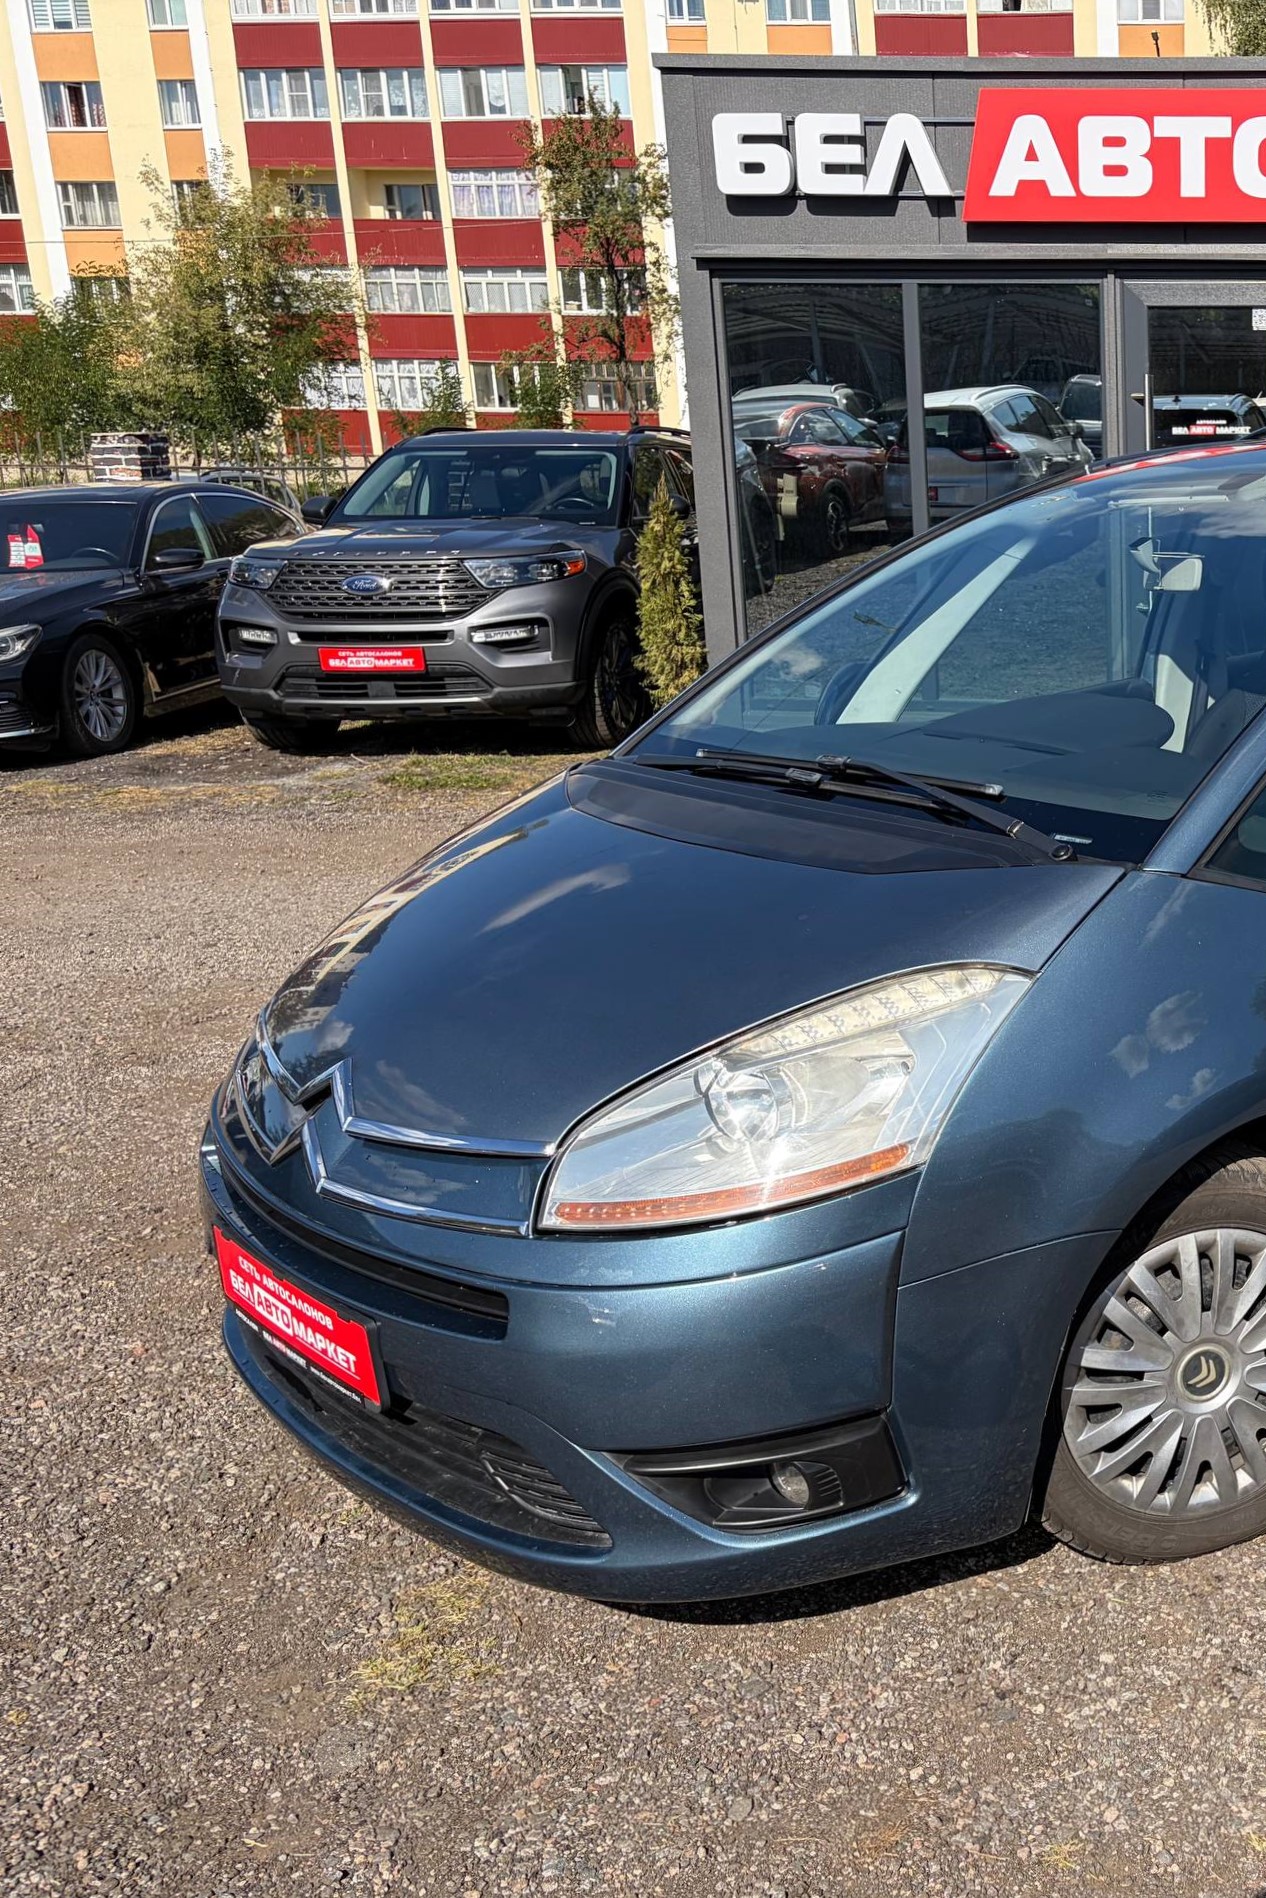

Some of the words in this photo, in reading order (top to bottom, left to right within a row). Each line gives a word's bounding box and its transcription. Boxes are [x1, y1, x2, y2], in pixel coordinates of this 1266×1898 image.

[711, 112, 955, 197] БЕЛ
[1216, 426, 1252, 435] МАРКЕТ
[352, 579, 377, 590] Ford
[348, 658, 373, 667] АВТО
[375, 658, 414, 667] МАРКЕТ
[238, 1256, 261, 1281] СЕТЬ
[263, 1273, 334, 1331] АВТОСАЛОНОВ
[229, 1268, 254, 1303] БЕЛ
[255, 1286, 292, 1334] АВТО
[292, 1316, 357, 1374] МАРКЕТ
